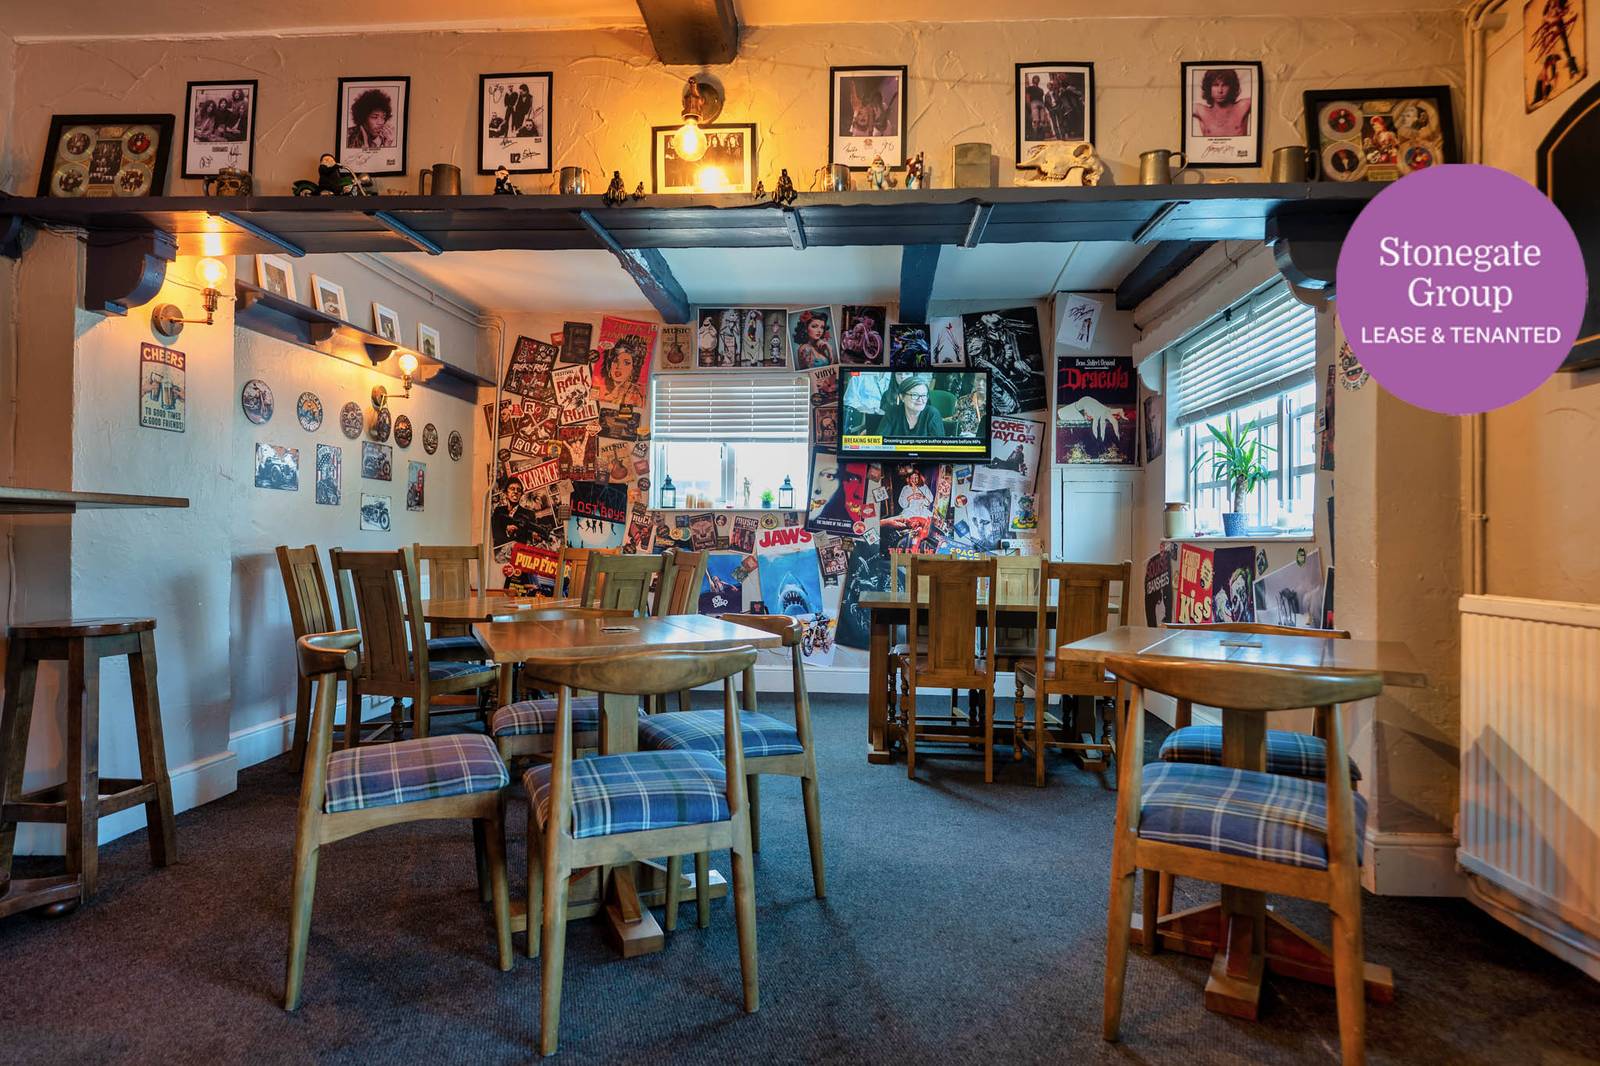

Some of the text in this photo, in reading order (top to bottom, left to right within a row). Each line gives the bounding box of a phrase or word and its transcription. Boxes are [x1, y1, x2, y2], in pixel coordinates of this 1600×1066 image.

[143, 347, 183, 369] CHEERS
[815, 368, 836, 379] VINYL
[1059, 366, 1129, 390] Dracula
[145, 407, 181, 421] TO GOOD TIMES
[148, 417, 161, 426] GOOD
[992, 420, 1034, 433] COREY
[517, 461, 559, 491] SCARFACE
[570, 500, 625, 522] LOST BOYS
[736, 517, 758, 529] MUSIC
[759, 527, 812, 548] JAWS
[515, 552, 540, 570] PULP
[826, 564, 846, 572] ROCK
